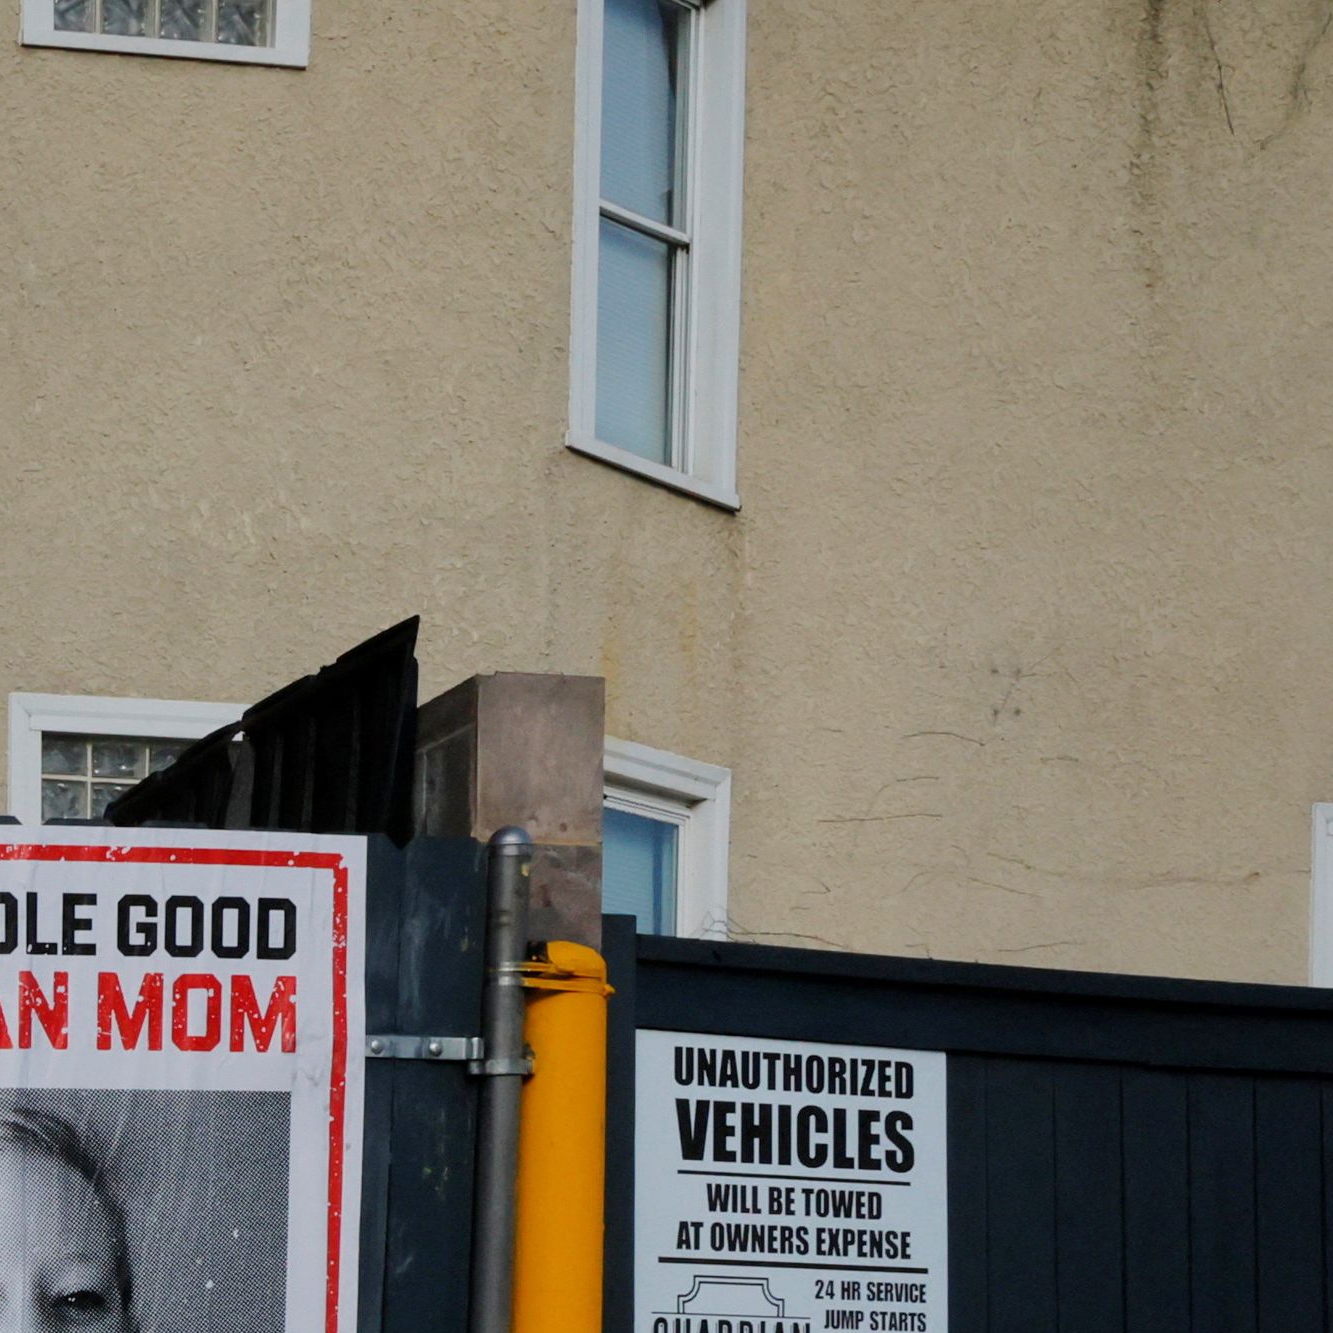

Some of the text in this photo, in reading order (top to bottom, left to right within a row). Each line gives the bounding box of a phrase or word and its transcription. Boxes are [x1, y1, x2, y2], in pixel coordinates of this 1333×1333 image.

[117, 894, 297, 960] GOOD
[96, 972, 297, 1053] MOM
[674, 1046, 914, 1099] UNAUTHORIZED
[675, 1098, 915, 1173] VEHICLES
[707, 1183, 882, 1220] WILL BE TOWED
[676, 1221, 911, 1260] AT OWNERS EXPENSE
[814, 1280, 926, 1303] 24 HR SERVICE
[824, 1310, 926, 1332] JUMP STARTS
